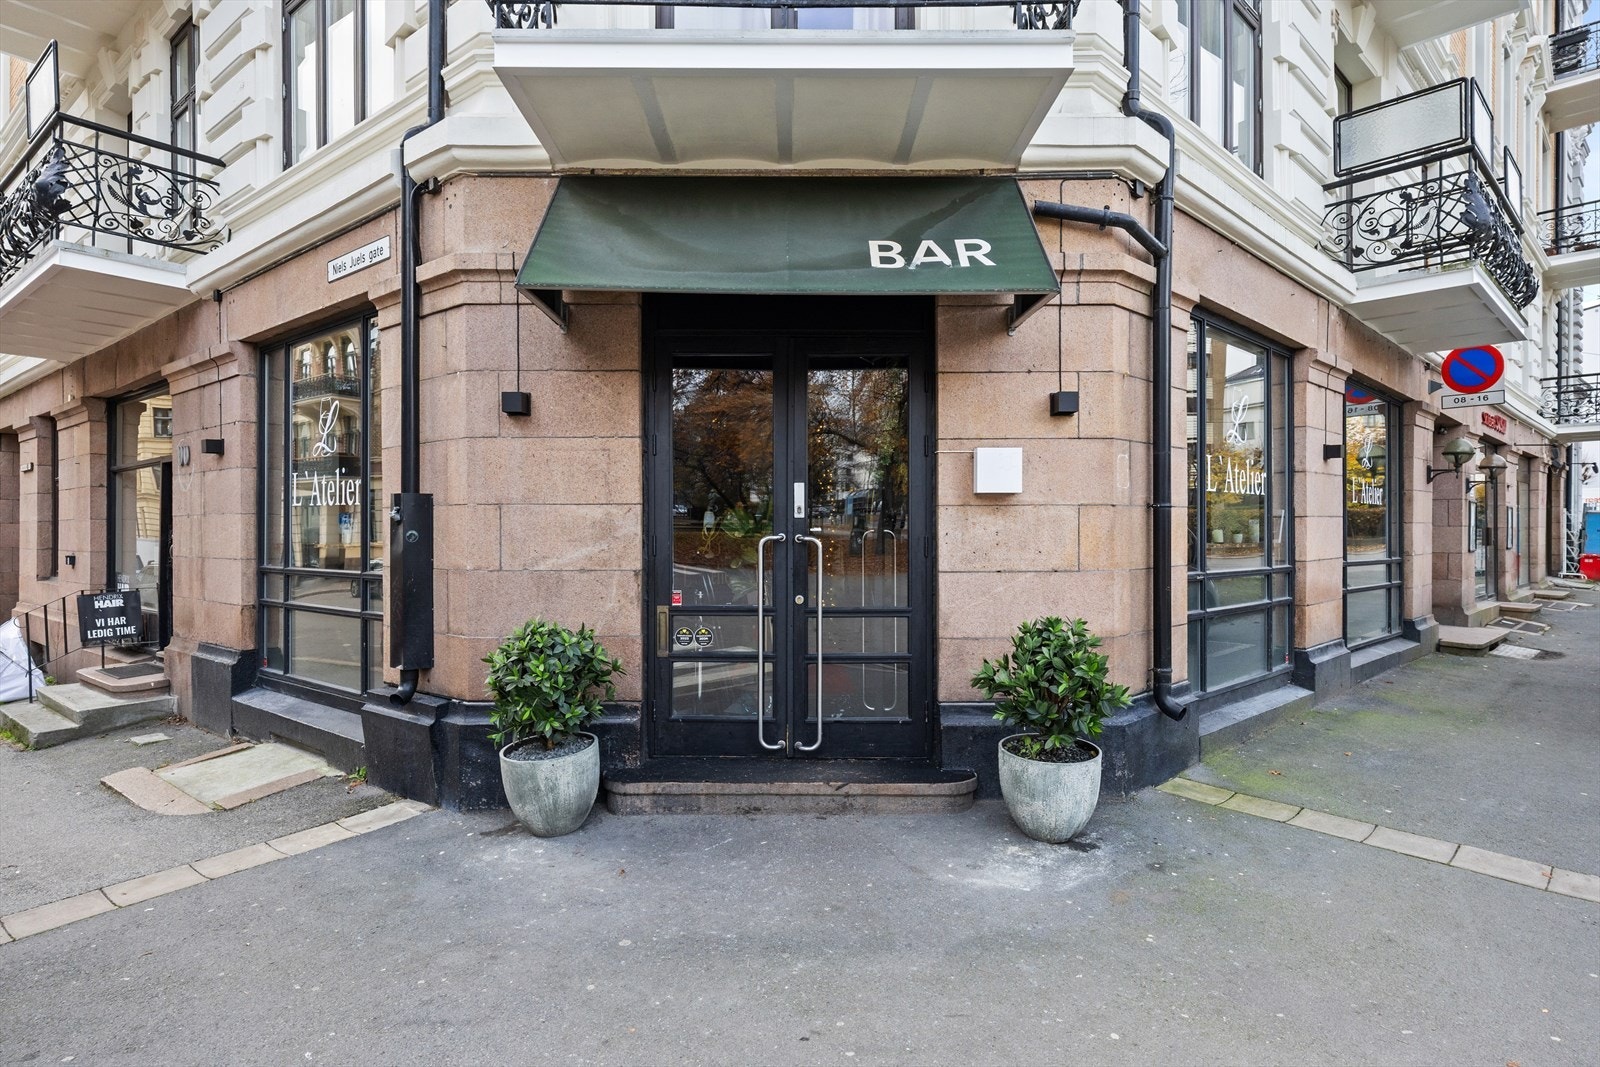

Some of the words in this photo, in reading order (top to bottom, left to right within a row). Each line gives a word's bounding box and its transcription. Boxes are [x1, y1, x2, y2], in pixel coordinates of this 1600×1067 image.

[868, 238, 997, 270] BAR
[332, 260, 347, 275] Niels
[350, 252, 366, 268] Juels
[368, 246, 384, 263] gate
[1453, 396, 1467, 404] 08
[1477, 394, 1489, 402] 16
[94, 599, 125, 609] HAIR
[95, 618, 105, 627] VI
[107, 616, 127, 626] HAR
[87, 628, 114, 639] LEDIG
[115, 625, 137, 636] TIME
